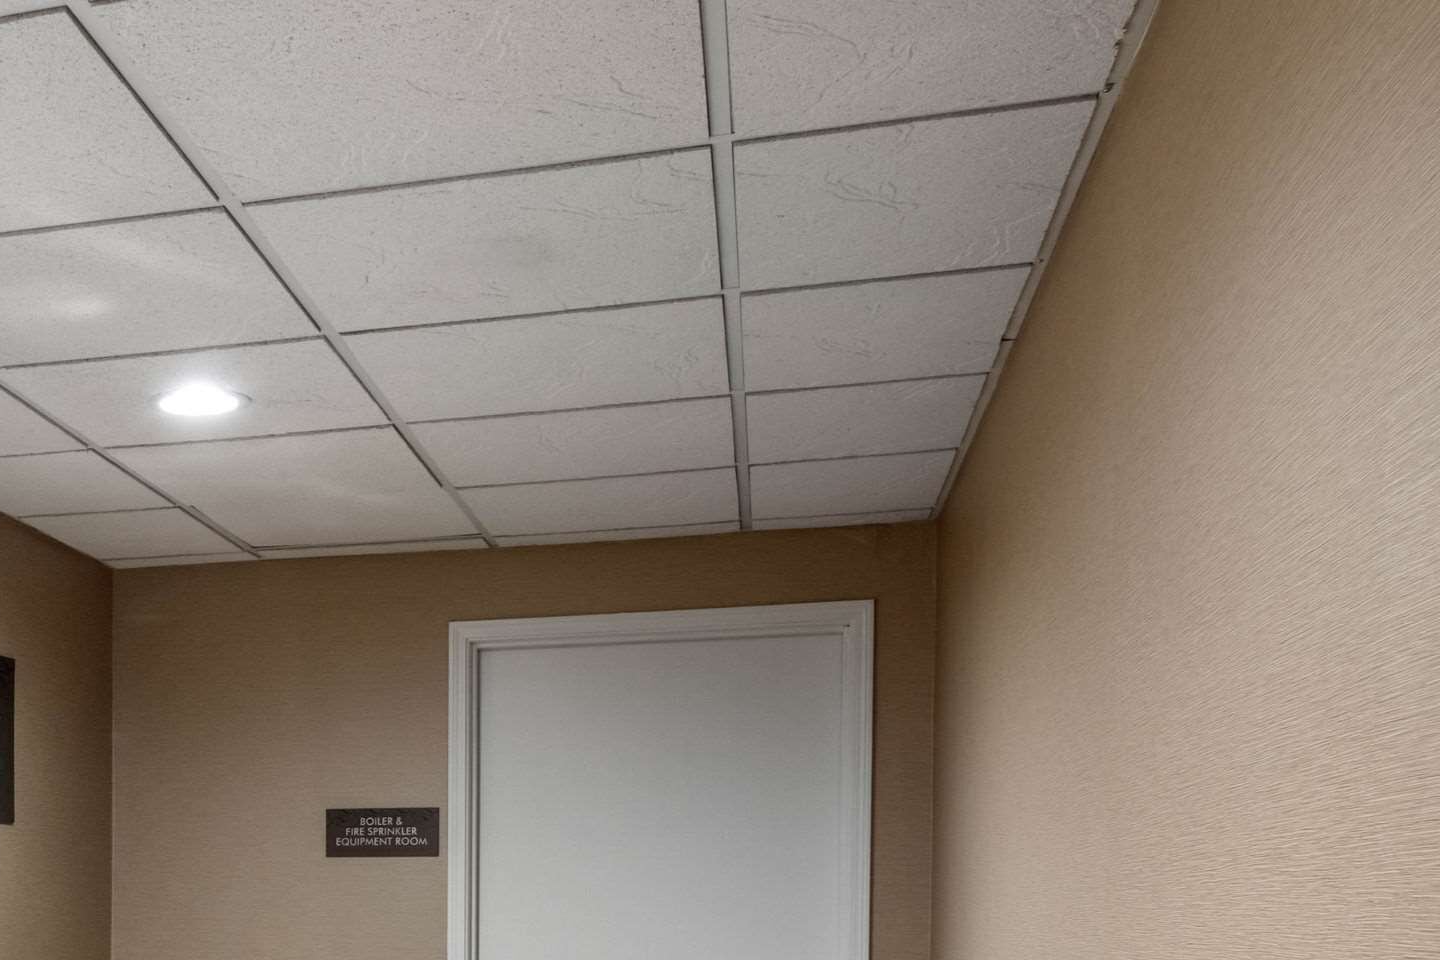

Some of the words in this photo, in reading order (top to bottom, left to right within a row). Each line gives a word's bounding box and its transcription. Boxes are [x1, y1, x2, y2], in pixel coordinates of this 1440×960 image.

[360, 816, 393, 826] BOILER
[396, 816, 402, 826] &
[345, 827, 365, 837] FIRE
[367, 826, 418, 836] SPRINKLER
[335, 837, 393, 847] EQUIPMENT
[395, 836, 428, 846] ROOM
